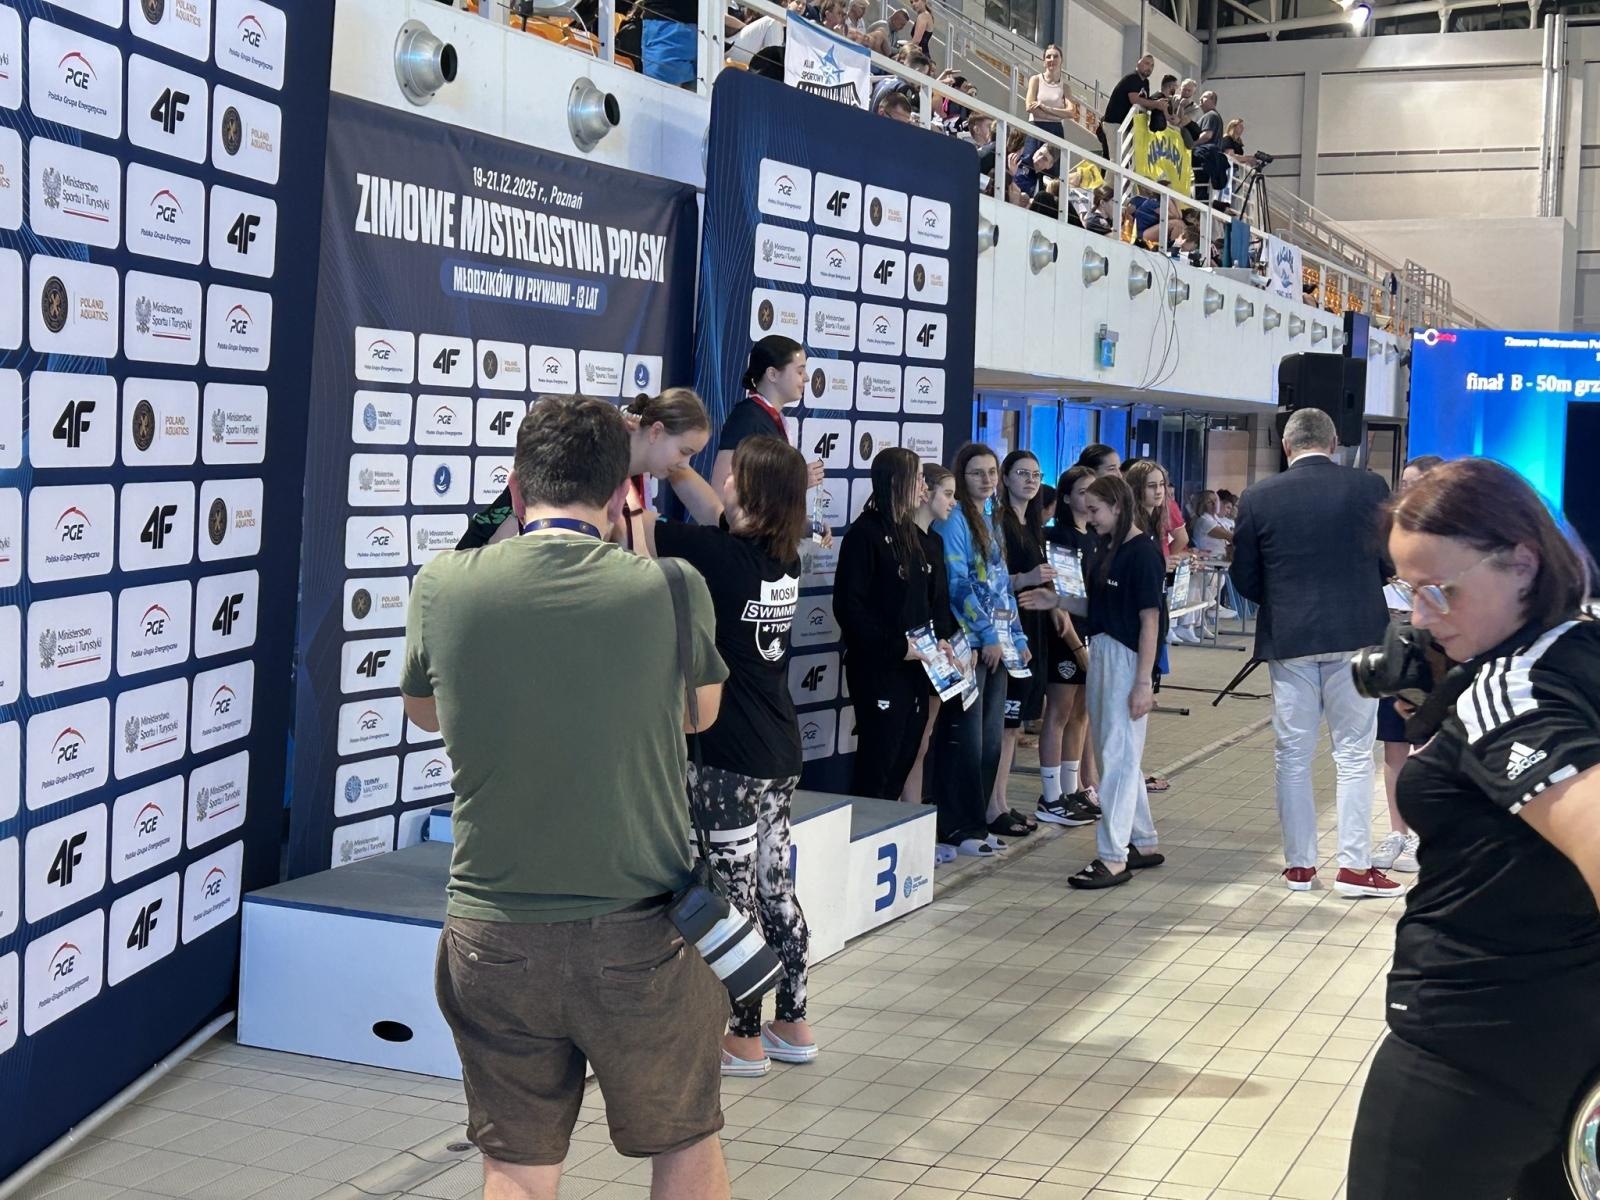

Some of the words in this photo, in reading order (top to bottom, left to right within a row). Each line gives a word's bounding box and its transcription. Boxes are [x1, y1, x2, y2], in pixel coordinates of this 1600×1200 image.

[242, 29, 261, 48] PGE
[66, 68, 90, 90] PGE
[48, 91, 63, 102] Polska
[64, 96, 77, 107] Grupa
[78, 100, 107, 115] Energetyczna
[150, 88, 189, 134] 4F
[251, 128, 269, 139] POLAND
[62, 174, 98, 193] Ministerstwo
[473, 166, 537, 198] 19-21.12.2025
[550, 186, 583, 210] Poznań
[778, 185, 792, 196] PGE
[63, 189, 81, 203] Sportu
[827, 190, 850, 217] 4F
[156, 205, 176, 223] PGE
[355, 173, 455, 248] ZIMOWE
[460, 196, 605, 274] MISTRZOSTWA
[227, 213, 260, 254] 4F
[874, 260, 895, 284] 4F
[453, 266, 514, 299] MŁODZIKÓW
[515, 279, 526, 300] W
[526, 277, 570, 306] PŁYWANIU
[576, 285, 584, 309] 13
[585, 287, 599, 311] LAT
[80, 298, 103, 310] POLAND
[80, 309, 108, 321] AQUATICS
[230, 320, 247, 334] PGE
[917, 324, 937, 347] 4F
[372, 349, 390, 359] PGE
[433, 348, 460, 374] 4F
[546, 365, 558, 374] PGE
[1466, 373, 1504, 390] finał
[1511, 374, 1523, 391] B
[1536, 374, 1572, 392] 50m
[53, 400, 96, 448] 4F
[165, 416, 185, 426] POLAND
[437, 415, 452, 424] PGE
[489, 411, 514, 435] 4F
[165, 426, 189, 436] AQUATICS
[814, 433, 839, 458] 4F
[62, 524, 84, 542] PGE
[140, 505, 177, 549] 4F
[372, 536, 389, 546] PGE
[771, 586, 795, 601] MOSM
[212, 593, 244, 636] 4F
[145, 620, 164, 637] PGE
[357, 650, 391, 678] 4F
[802, 665, 827, 691] 4F
[214, 699, 231, 716] PGE
[361, 719, 377, 730] PGE
[57, 743, 79, 764] PGE
[426, 767, 442, 779] PGE
[1507, 750, 1547, 780] adidas
[139, 816, 157, 837] PGE
[47, 831, 87, 887] 4F
[875, 843, 897, 912] 3
[205, 879, 221, 899] PGE
[127, 898, 162, 950] 4F
[54, 955, 74, 981] PGE
